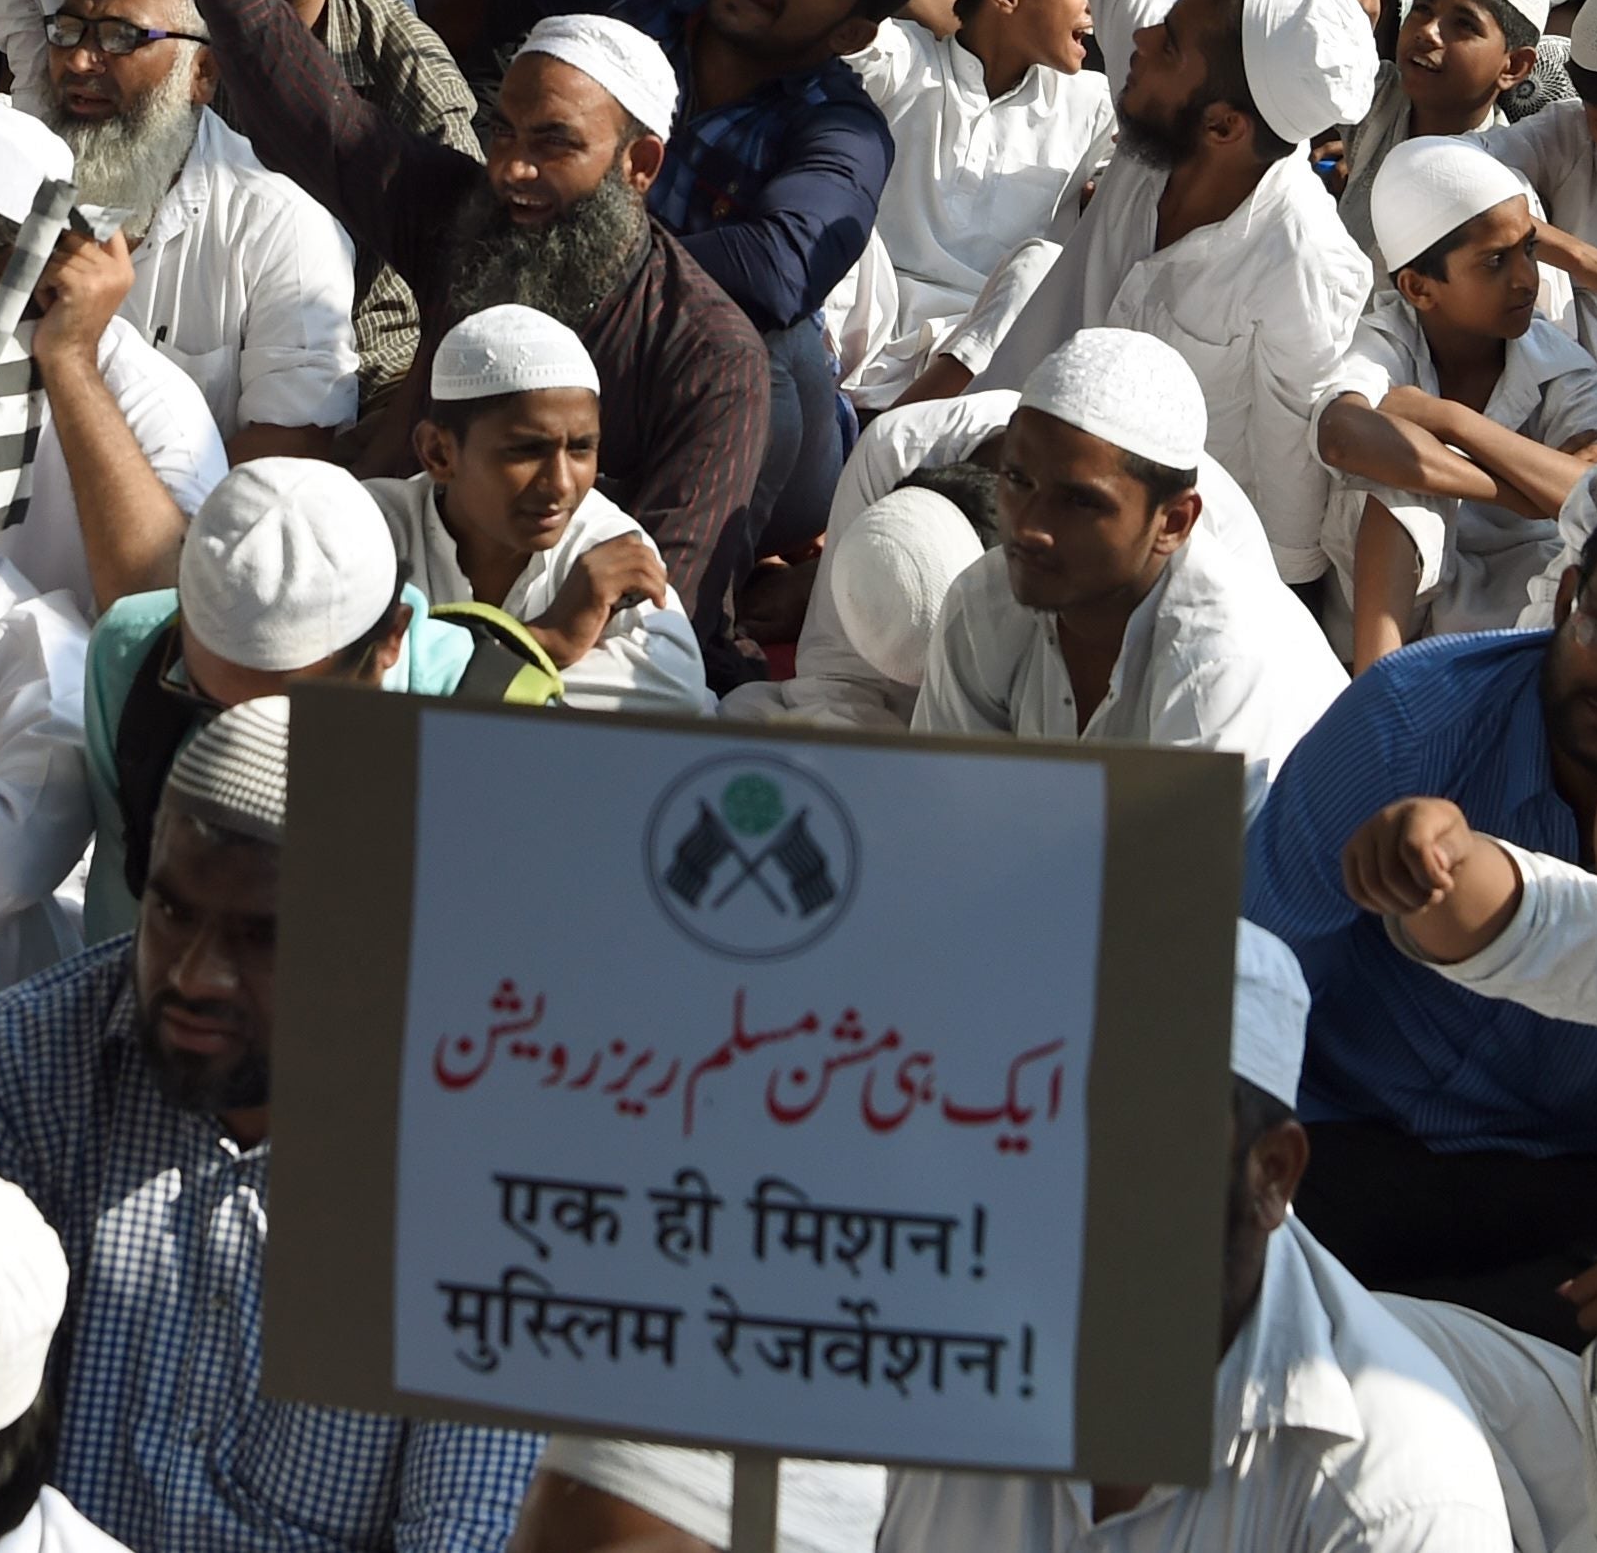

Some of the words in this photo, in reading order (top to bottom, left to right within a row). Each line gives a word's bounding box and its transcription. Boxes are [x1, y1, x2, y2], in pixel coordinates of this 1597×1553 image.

[432, 977, 682, 1117] ریزرویشن
[682, 984, 821, 1137] مسلم
[764, 1007, 902, 1125] مشن
[860, 1049, 935, 1133] ہی
[941, 1037, 1067, 1155] ایک
[492, 1172, 628, 1261] एक
[647, 1166, 723, 1267] ही
[747, 1177, 989, 1279] मिशन!
[435, 1267, 685, 1374] मुस्लिम
[707, 1286, 1037, 1398] रेजर्वेशन!
